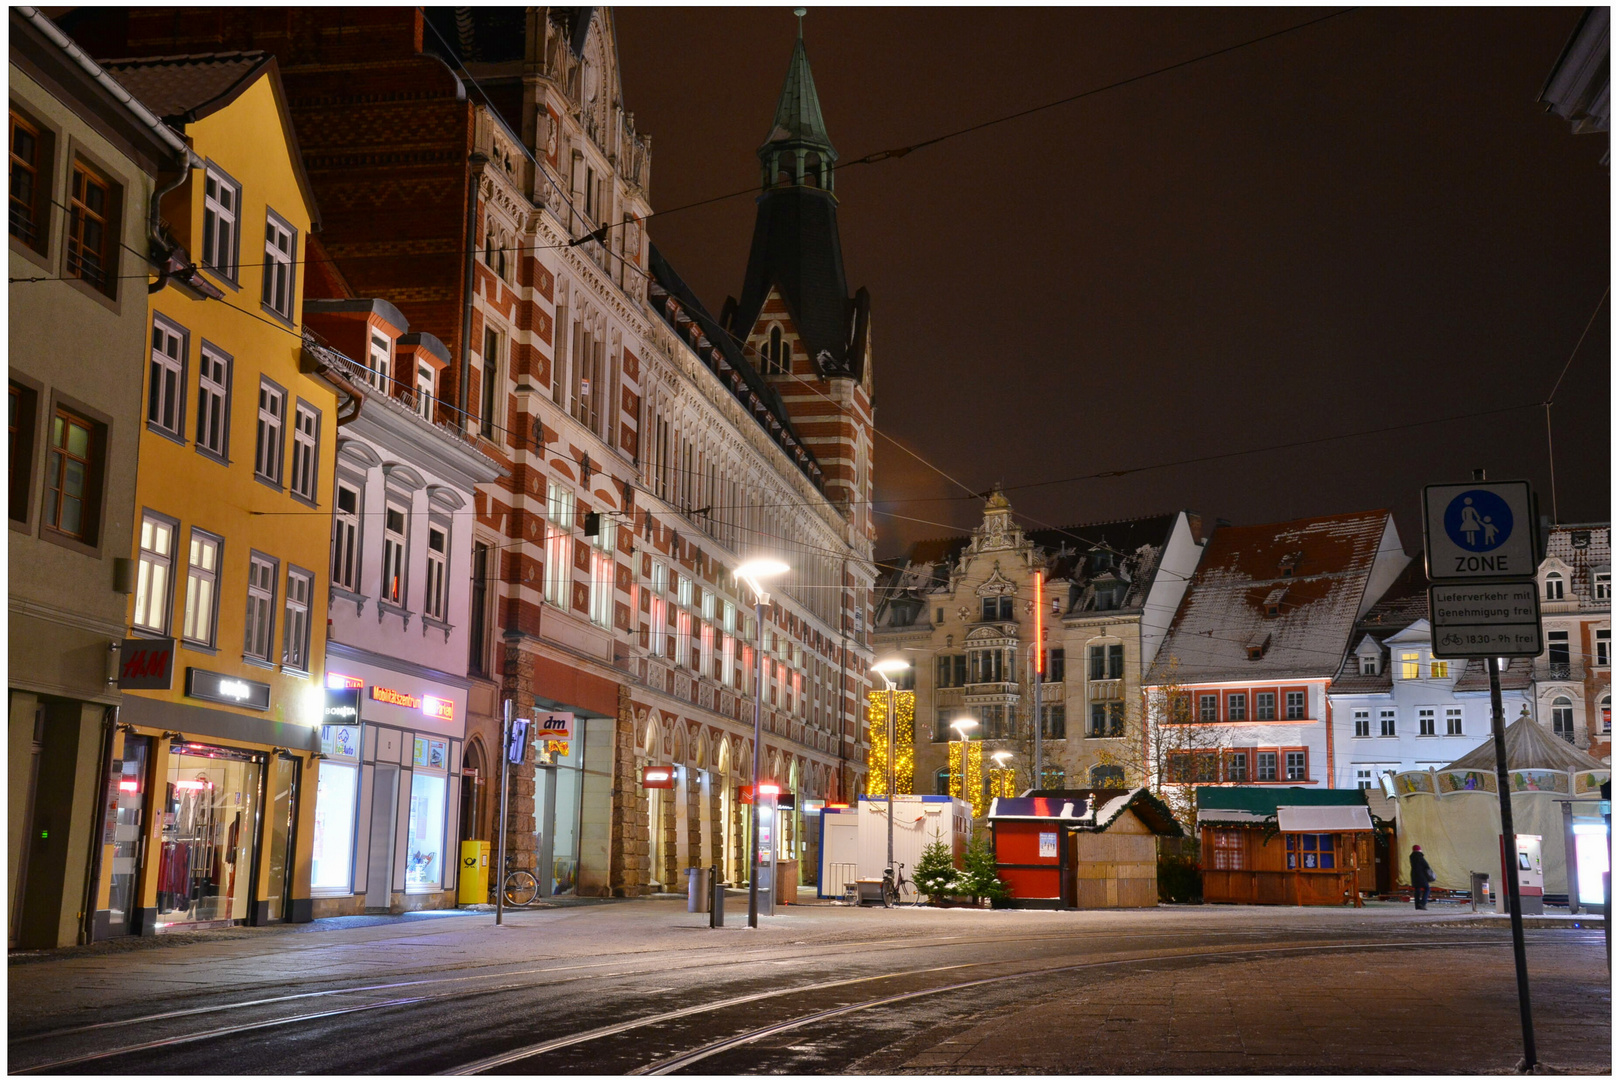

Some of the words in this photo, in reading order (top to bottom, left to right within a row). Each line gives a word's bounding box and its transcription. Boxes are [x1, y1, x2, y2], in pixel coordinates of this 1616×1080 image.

[1455, 555, 1508, 572] ZONE
[1437, 592, 1509, 602] Lieferverkehr
[1513, 591, 1530, 600] mit
[1438, 608, 1510, 618] Genehmigung
[1514, 607, 1533, 615] frei
[1515, 634, 1534, 643] frei
[123, 650, 168, 679] H&M
[325, 706, 356, 718] BONITA
[543, 716, 566, 729] dm
